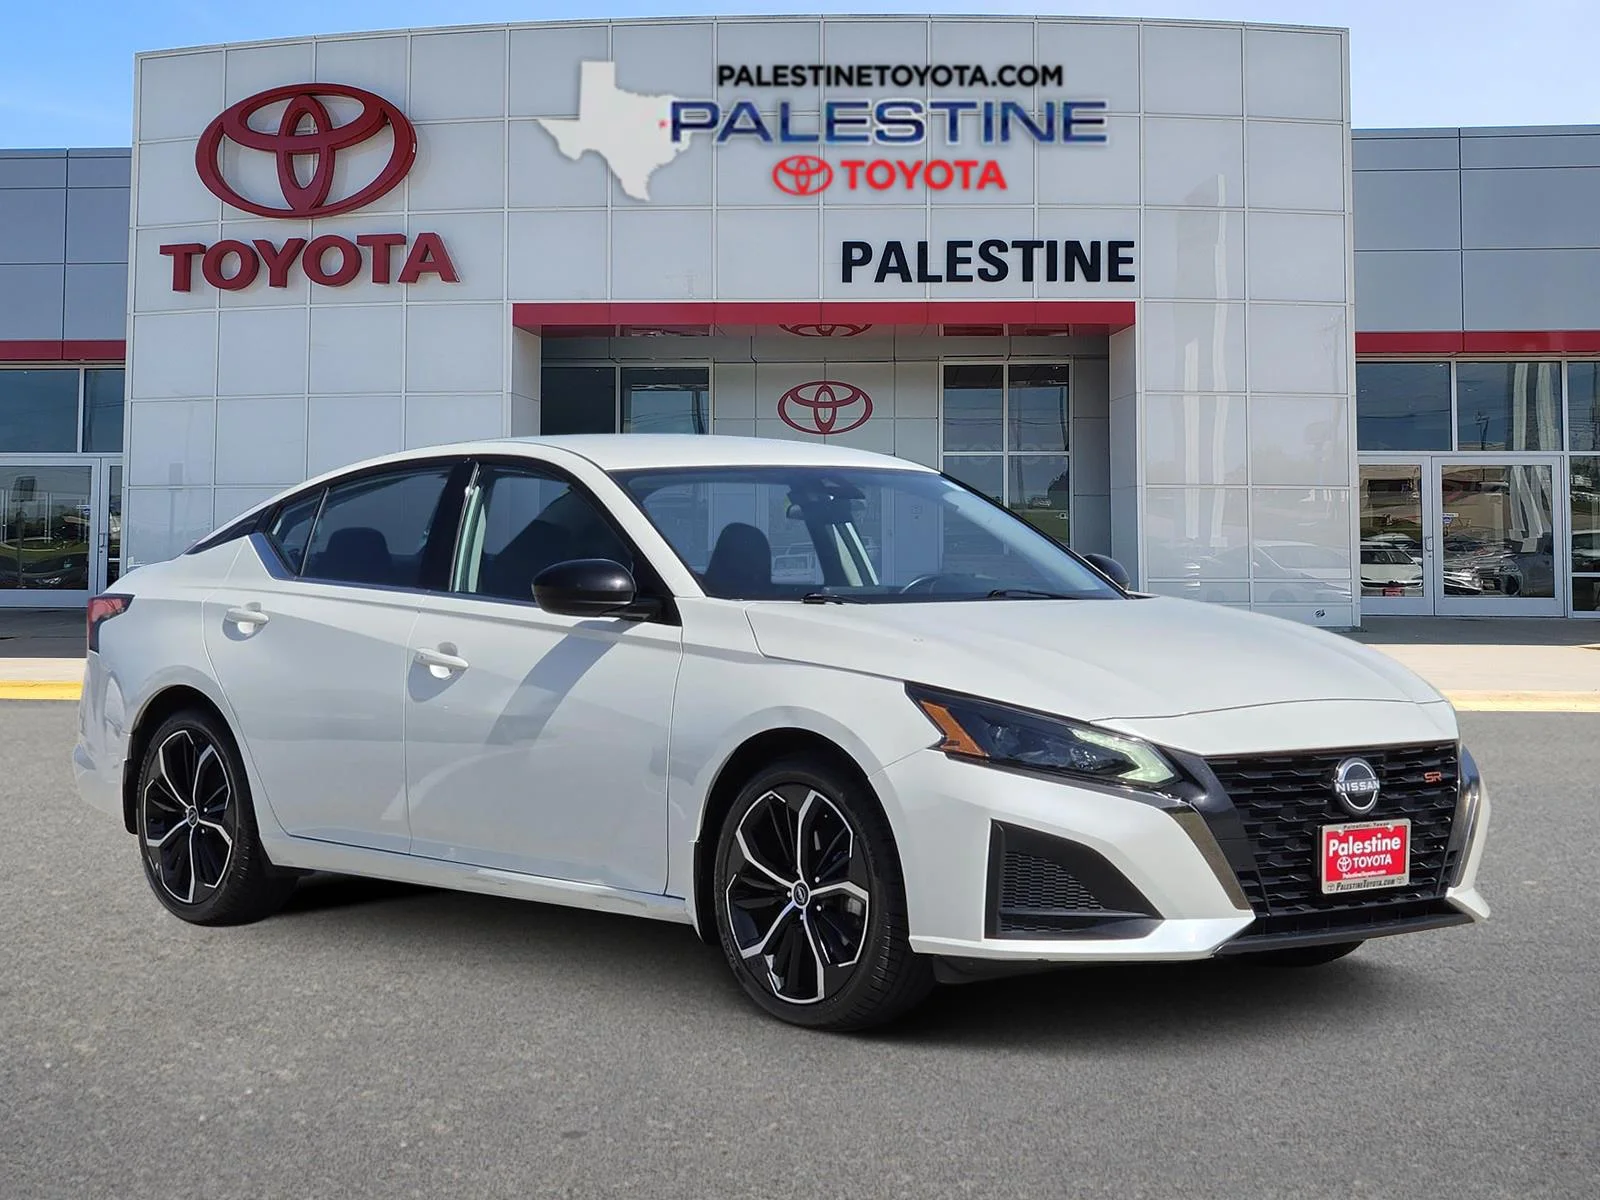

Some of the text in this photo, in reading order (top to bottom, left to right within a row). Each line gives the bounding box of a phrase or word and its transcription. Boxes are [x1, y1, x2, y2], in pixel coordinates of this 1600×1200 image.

[159, 231, 460, 292] TOYOTA
[841, 239, 1136, 284] PALESTINE
[1335, 779, 1380, 793] NISSAN
[1328, 833, 1401, 857] Palestine
[1353, 854, 1393, 869] TOYOTA
